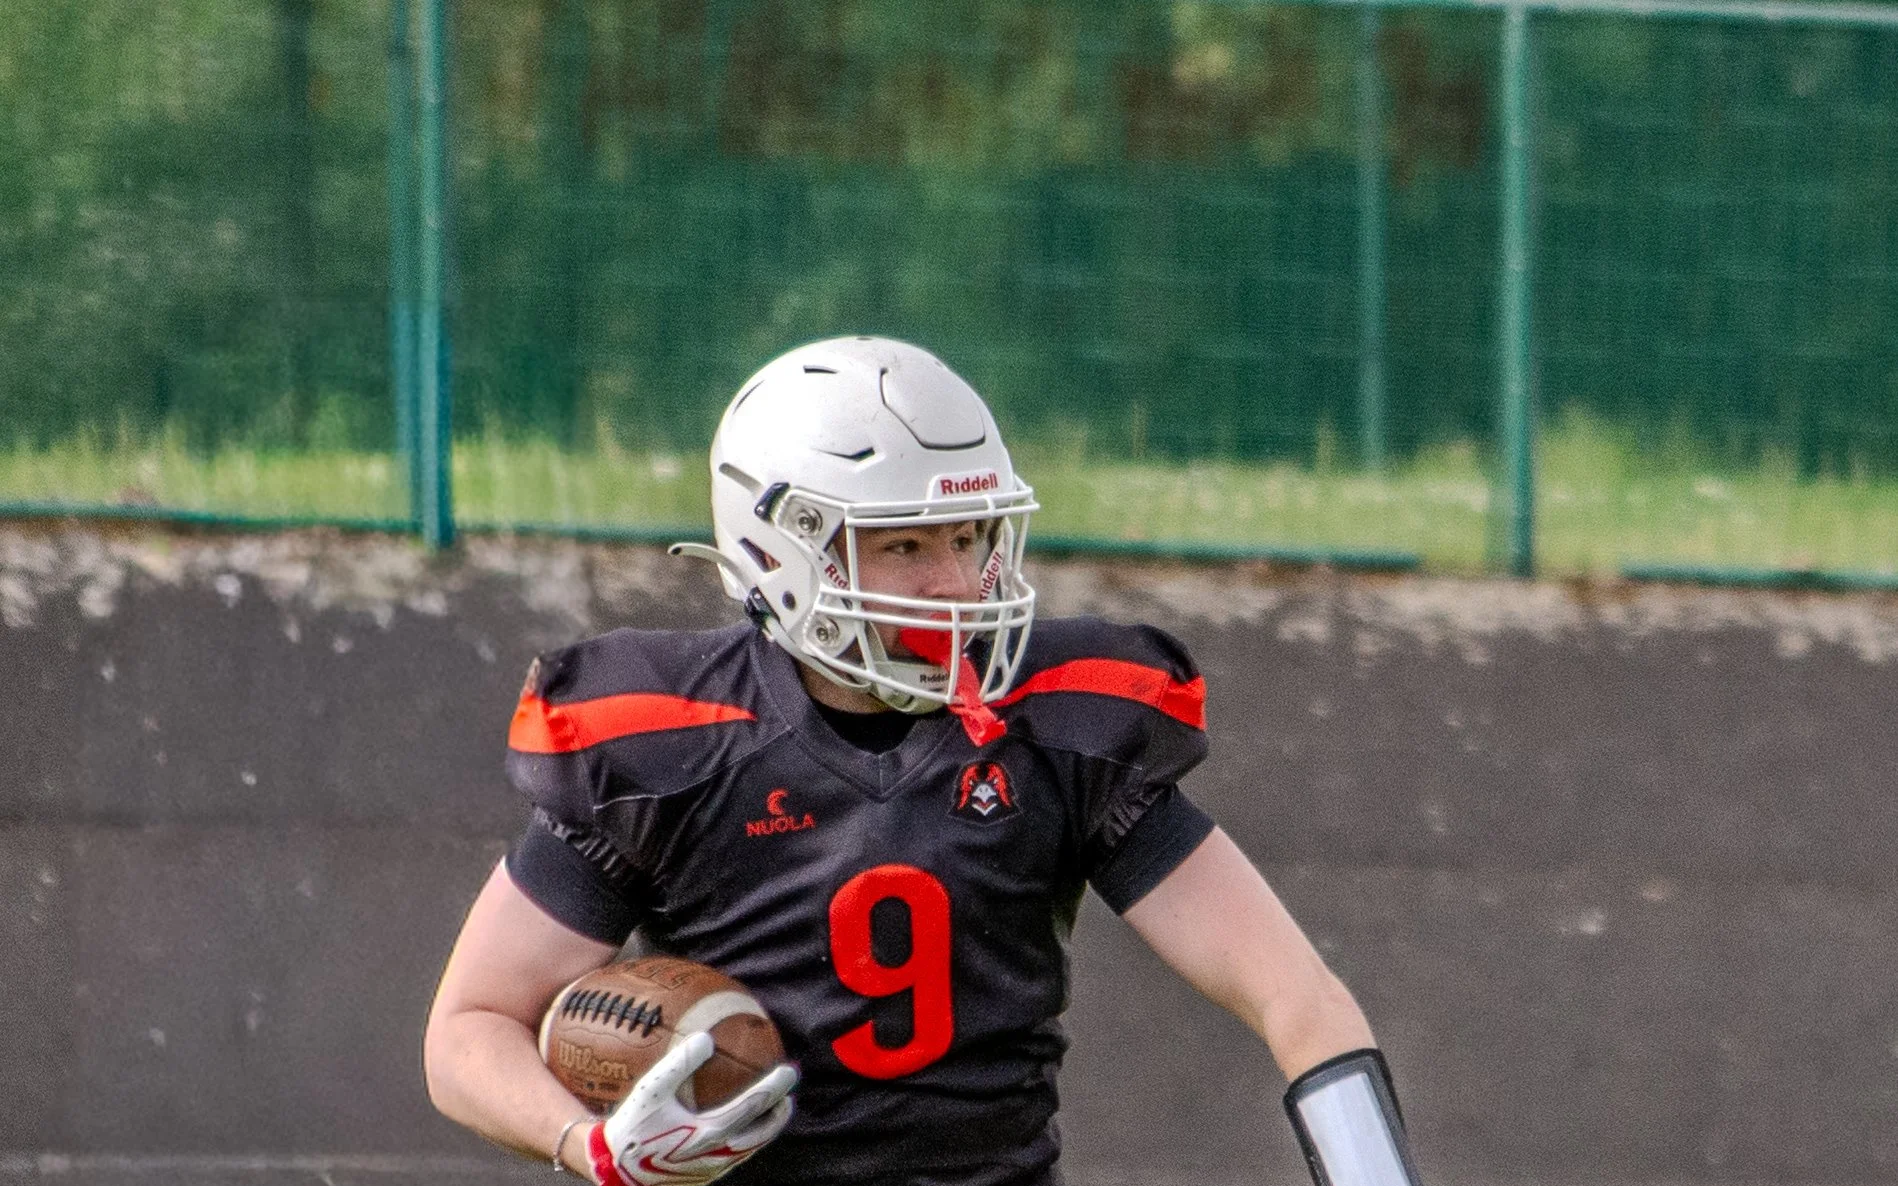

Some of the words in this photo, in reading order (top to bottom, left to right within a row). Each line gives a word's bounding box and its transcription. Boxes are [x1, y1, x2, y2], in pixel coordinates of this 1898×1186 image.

[940, 472, 999, 496] Riddell
[745, 812, 816, 838] NUOLA
[828, 863, 954, 1080] 9
[558, 1039, 630, 1081] Wilson
